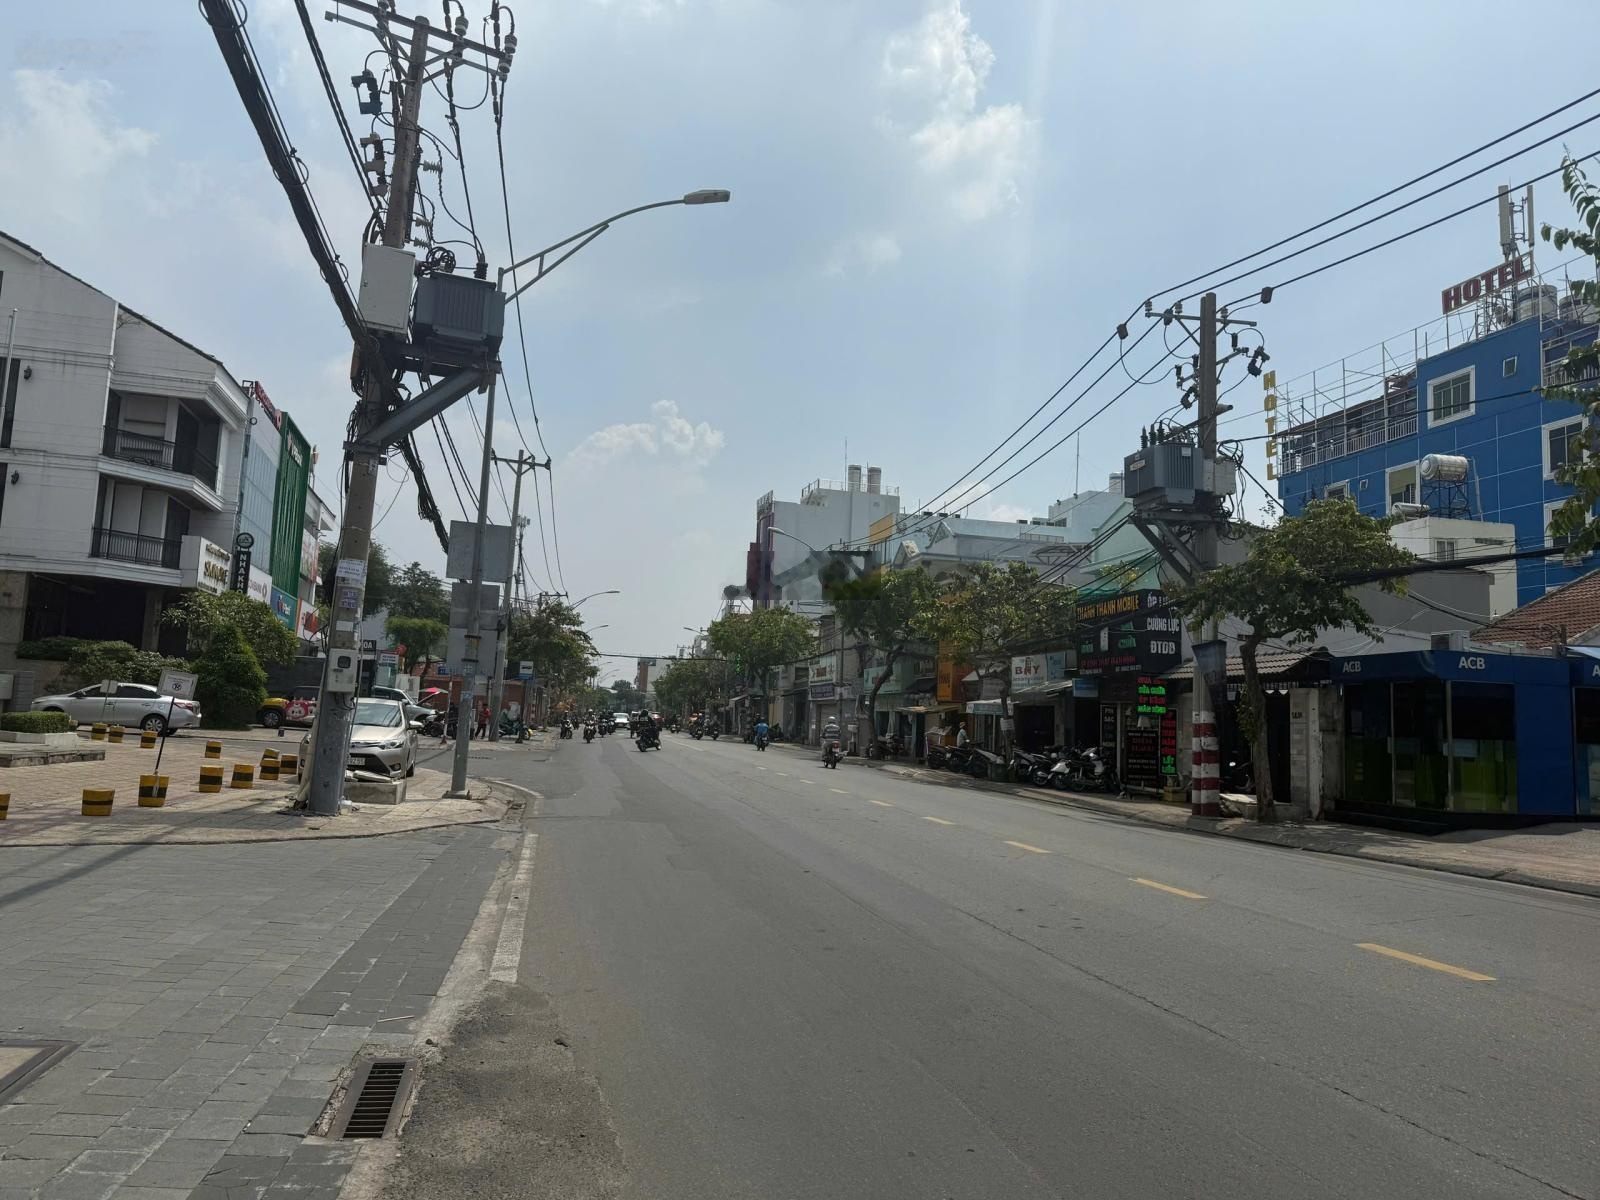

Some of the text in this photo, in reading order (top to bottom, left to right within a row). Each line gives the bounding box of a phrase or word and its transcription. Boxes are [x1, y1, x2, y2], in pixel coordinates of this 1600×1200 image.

[1443, 258, 1532, 314] HOTEL
[1263, 370, 1277, 481] HOTEL
[1116, 595, 1139, 613] MOBILE
[1342, 660, 1362, 673] ACB
[1458, 657, 1486, 670] ACB
